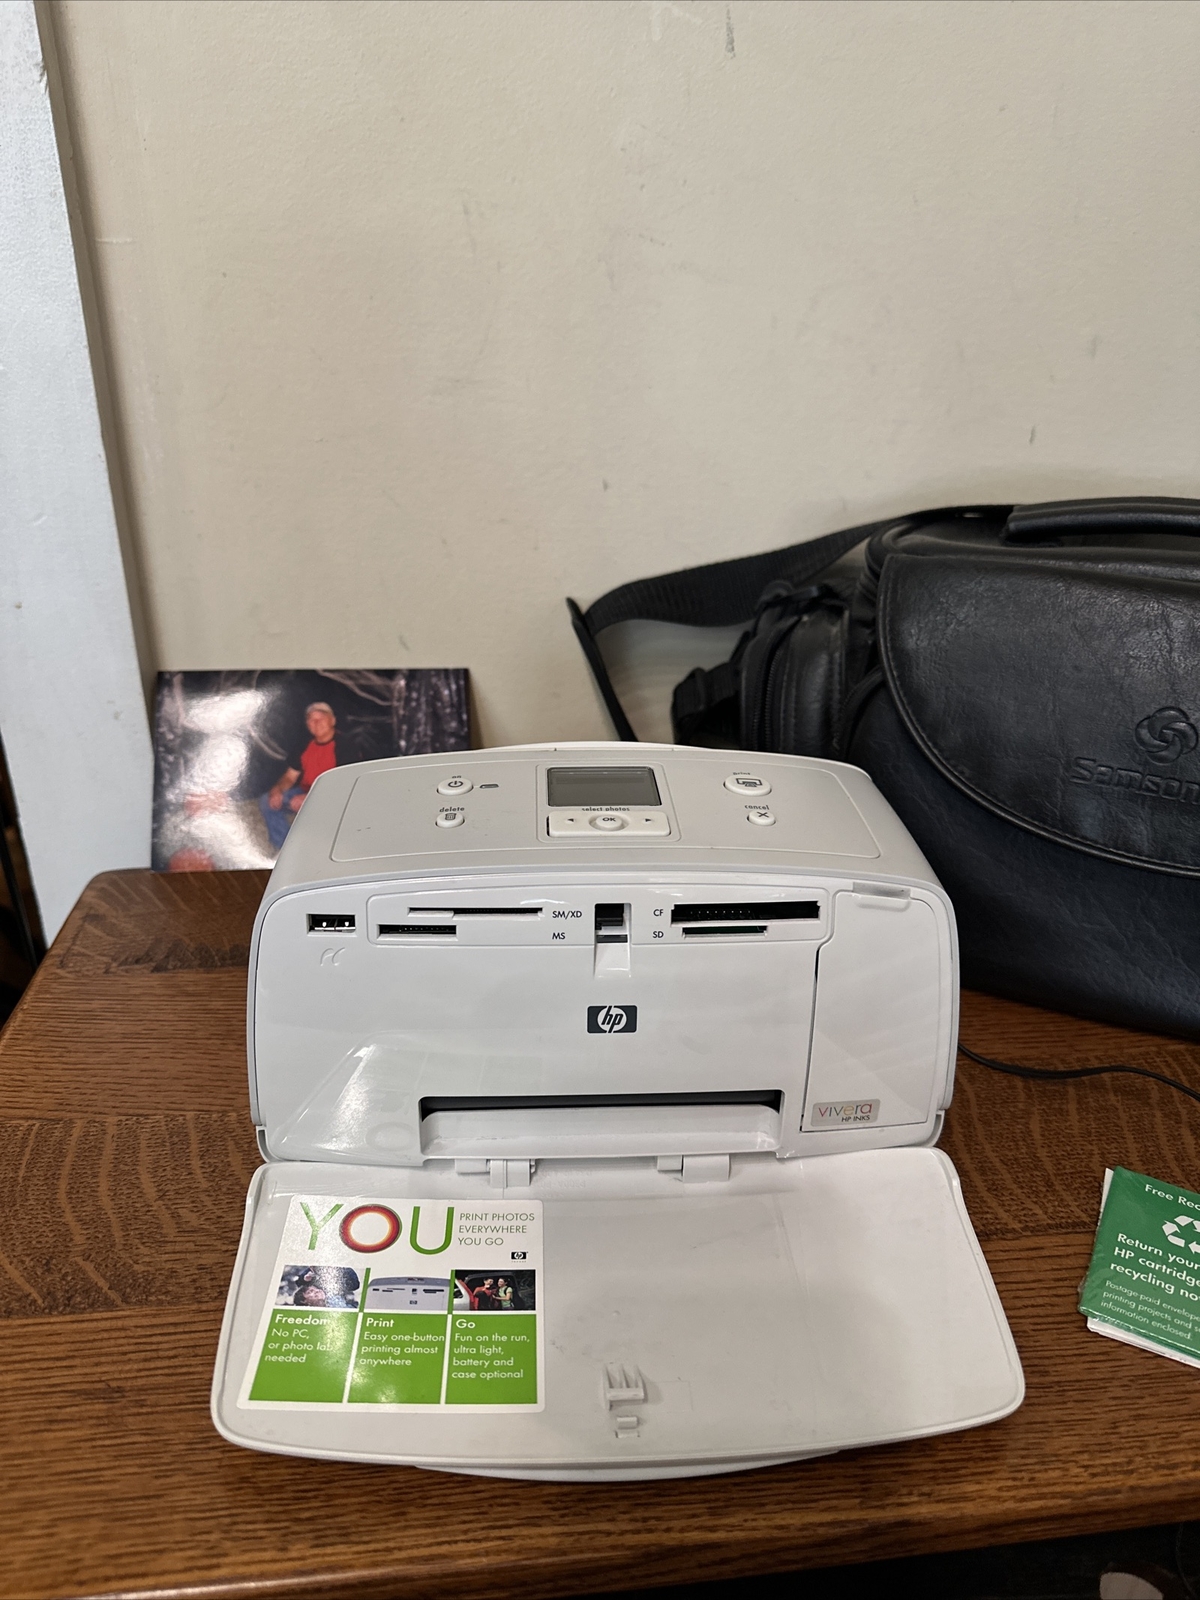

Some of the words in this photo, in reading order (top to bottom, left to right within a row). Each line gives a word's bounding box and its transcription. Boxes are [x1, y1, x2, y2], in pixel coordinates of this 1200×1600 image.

[551, 910, 583, 920] SM/XD
[653, 909, 664, 917] CF
[551, 932, 566, 940] MS
[652, 930, 664, 939] SD
[598, 1005, 627, 1033] hp
[818, 1103, 873, 1117] vivera
[1145, 1184, 1174, 1201] Free
[459, 1212, 489, 1221] PRINT
[491, 1212, 535, 1221] PHOTOS
[299, 1201, 455, 1255] YOU
[458, 1225, 527, 1233] EVERYWHERE
[457, 1237, 482, 1246] YOU
[484, 1237, 504, 1246] GO
[1114, 1246, 1135, 1260] HP
[1117, 1233, 1163, 1256] Return
[1168, 1253, 1200, 1270] your
[1110, 1263, 1175, 1295] recycling
[1180, 1288, 1200, 1301] no
[1101, 1300, 1149, 1324] information
[1102, 1291, 1136, 1309] printing
[1137, 1304, 1171, 1321] projects
[1174, 1317, 1192, 1329] and
[365, 1317, 395, 1327] Print
[455, 1319, 476, 1329] Go
[271, 1328, 289, 1337] No
[292, 1328, 310, 1339] PC,
[363, 1331, 388, 1342] Easy
[391, 1332, 445, 1341] one-button
[454, 1332, 473, 1341] Fun
[491, 1332, 508, 1341] the
[510, 1335, 530, 1343] run,
[282, 1341, 314, 1352] photo
[361, 1344, 401, 1356] printing
[403, 1344, 438, 1354] almost
[453, 1344, 477, 1354] ultra
[479, 1344, 504, 1356] light,
[264, 1353, 307, 1363] needed
[359, 1356, 412, 1367] anywhere
[452, 1356, 490, 1368] battery
[493, 1357, 514, 1366] and
[451, 1371, 477, 1379] case
[479, 1369, 524, 1380] optional
